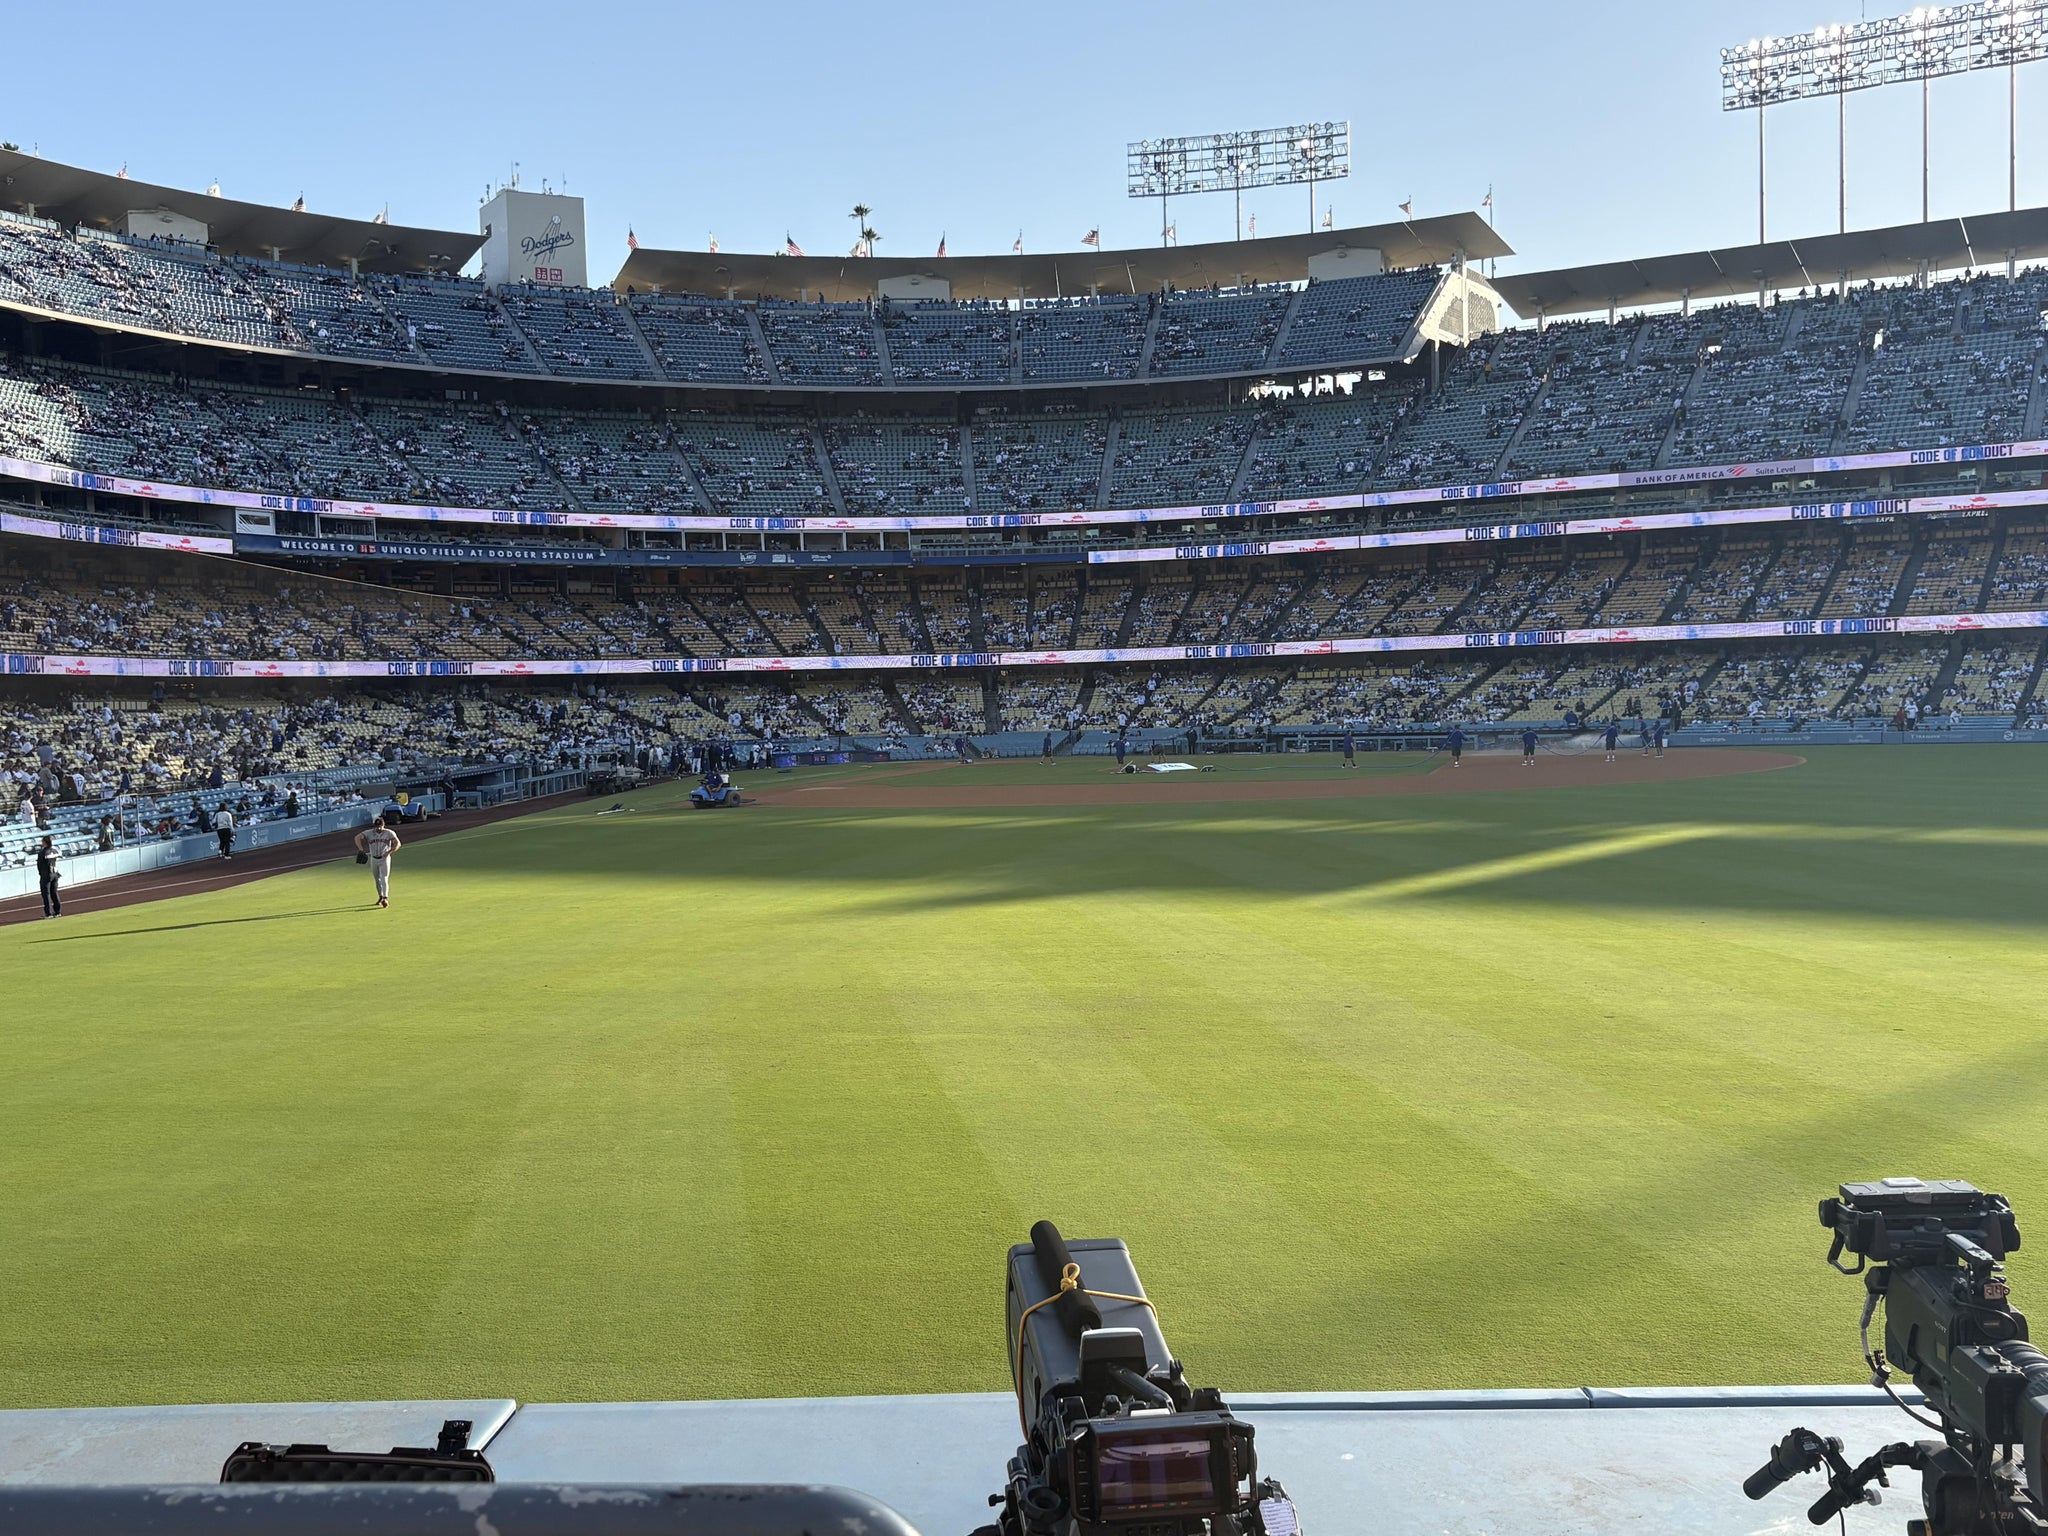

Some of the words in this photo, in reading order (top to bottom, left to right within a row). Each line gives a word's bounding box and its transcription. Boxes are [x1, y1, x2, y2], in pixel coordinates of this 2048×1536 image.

[521, 232, 574, 256] Dodgers
[1911, 450, 1940, 463] CODE
[1944, 448, 1957, 461] OF
[1756, 467, 1774, 475] Suite
[1777, 466, 1796, 474] Level
[51, 469, 70, 484] CODE
[72, 472, 80, 487] OF
[1636, 476, 1663, 484] BANK
[1680, 471, 1725, 480] AMERICA
[1441, 488, 1464, 499] CODE
[1467, 486, 1478, 497] OF
[261, 496, 282, 509] CODE
[284, 498, 294, 510] OF
[492, 511, 515, 522] CODE
[517, 512, 527, 523] OF
[1202, 506, 1223, 516] CODE
[1226, 505, 1236, 516] OF
[1792, 505, 1825, 518] CODE
[1831, 503, 1846, 517] OF
[730, 518, 752, 528] CODE
[755, 518, 765, 529] OF
[967, 516, 988, 526] CODE
[991, 516, 1001, 526] OF
[60, 523, 82, 540] CODE
[85, 526, 96, 542] OF
[1466, 527, 1495, 540] CODE
[1499, 526, 1512, 538] OF
[281, 541, 335, 550] WELCOME
[381, 546, 427, 554] UNIQLO
[432, 548, 464, 556] FIELD
[489, 550, 536, 558] DODGER
[542, 551, 594, 559] STADIUM
[1176, 546, 1203, 558] CODE
[1207, 546, 1219, 557] OF
[1784, 621, 1816, 634] CODE
[1821, 620, 1836, 633] OF
[1465, 635, 1494, 646] CODE
[1498, 634, 1511, 645] OF
[1186, 647, 1212, 657] CODE
[1216, 646, 1227, 656] OF
[652, 660, 679, 671] CODE
[683, 659, 694, 671] OF
[911, 655, 938, 666] CODE
[941, 655, 952, 666] OF
[169, 661, 187, 675] CODE
[189, 661, 198, 675] OF
[388, 662, 413, 674] CODE
[415, 662, 427, 675] OF
[1980, 1510, 2014, 1520] Vnen
